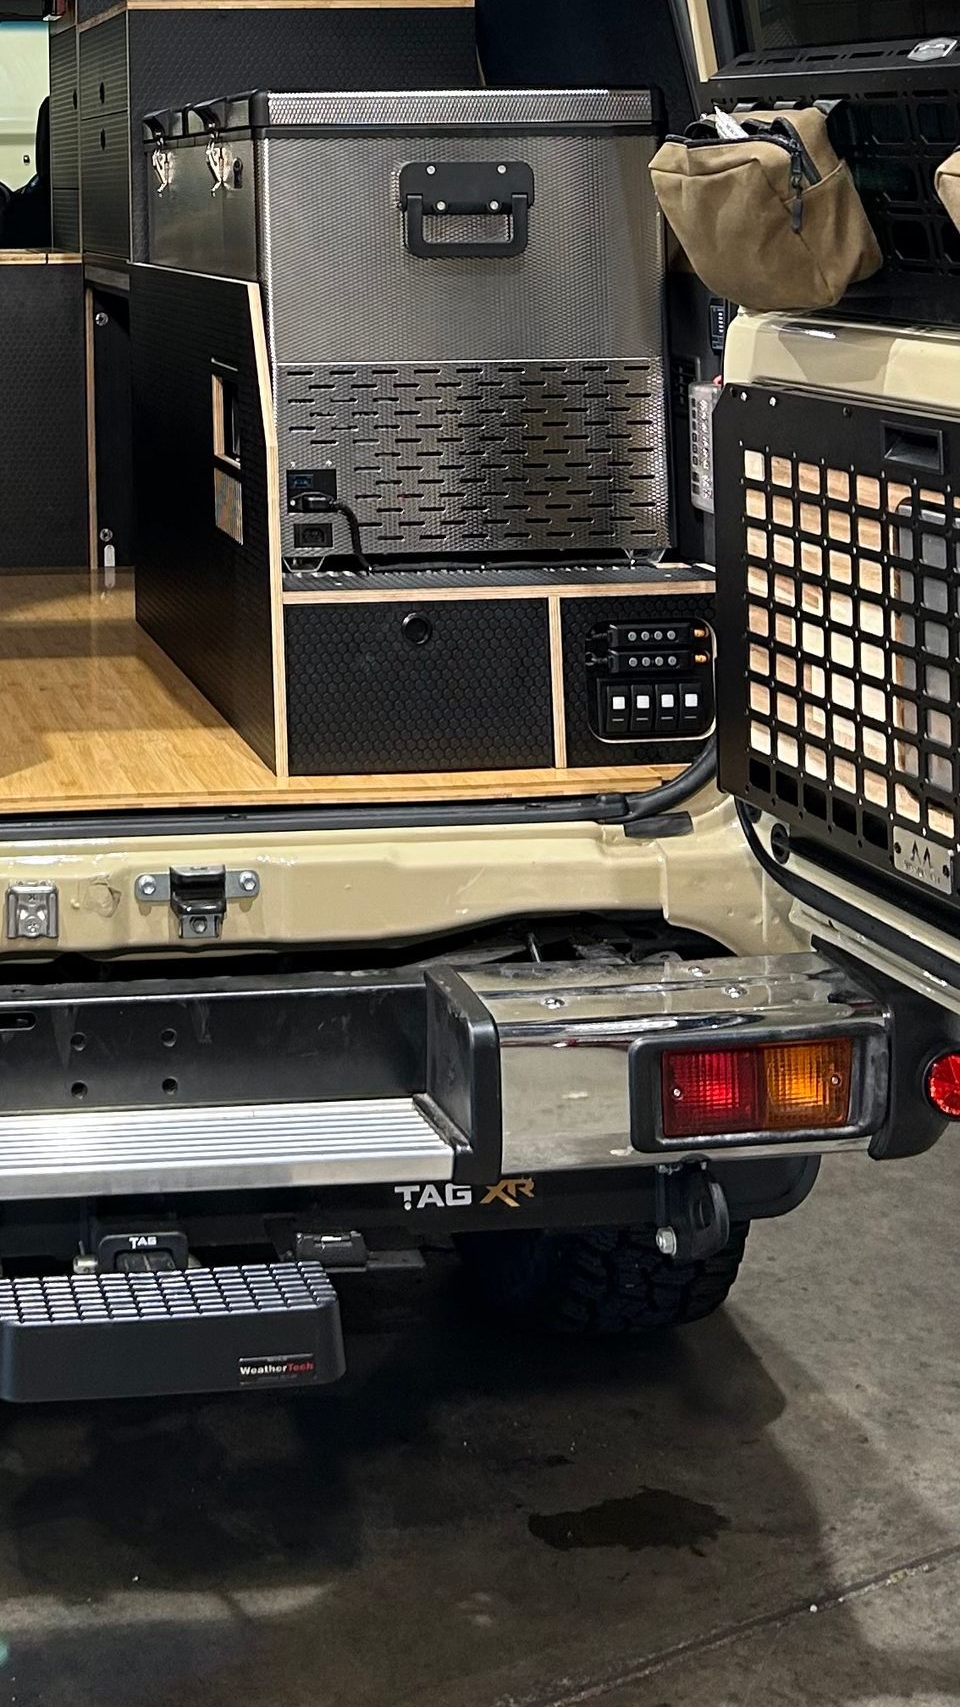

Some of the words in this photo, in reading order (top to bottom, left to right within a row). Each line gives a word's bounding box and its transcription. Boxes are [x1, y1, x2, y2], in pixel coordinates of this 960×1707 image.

[394, 1183, 473, 1211] TAG
[480, 1178, 535, 1208] XR
[129, 1236, 157, 1249] TAG
[240, 1362, 315, 1375] WeatherTech
